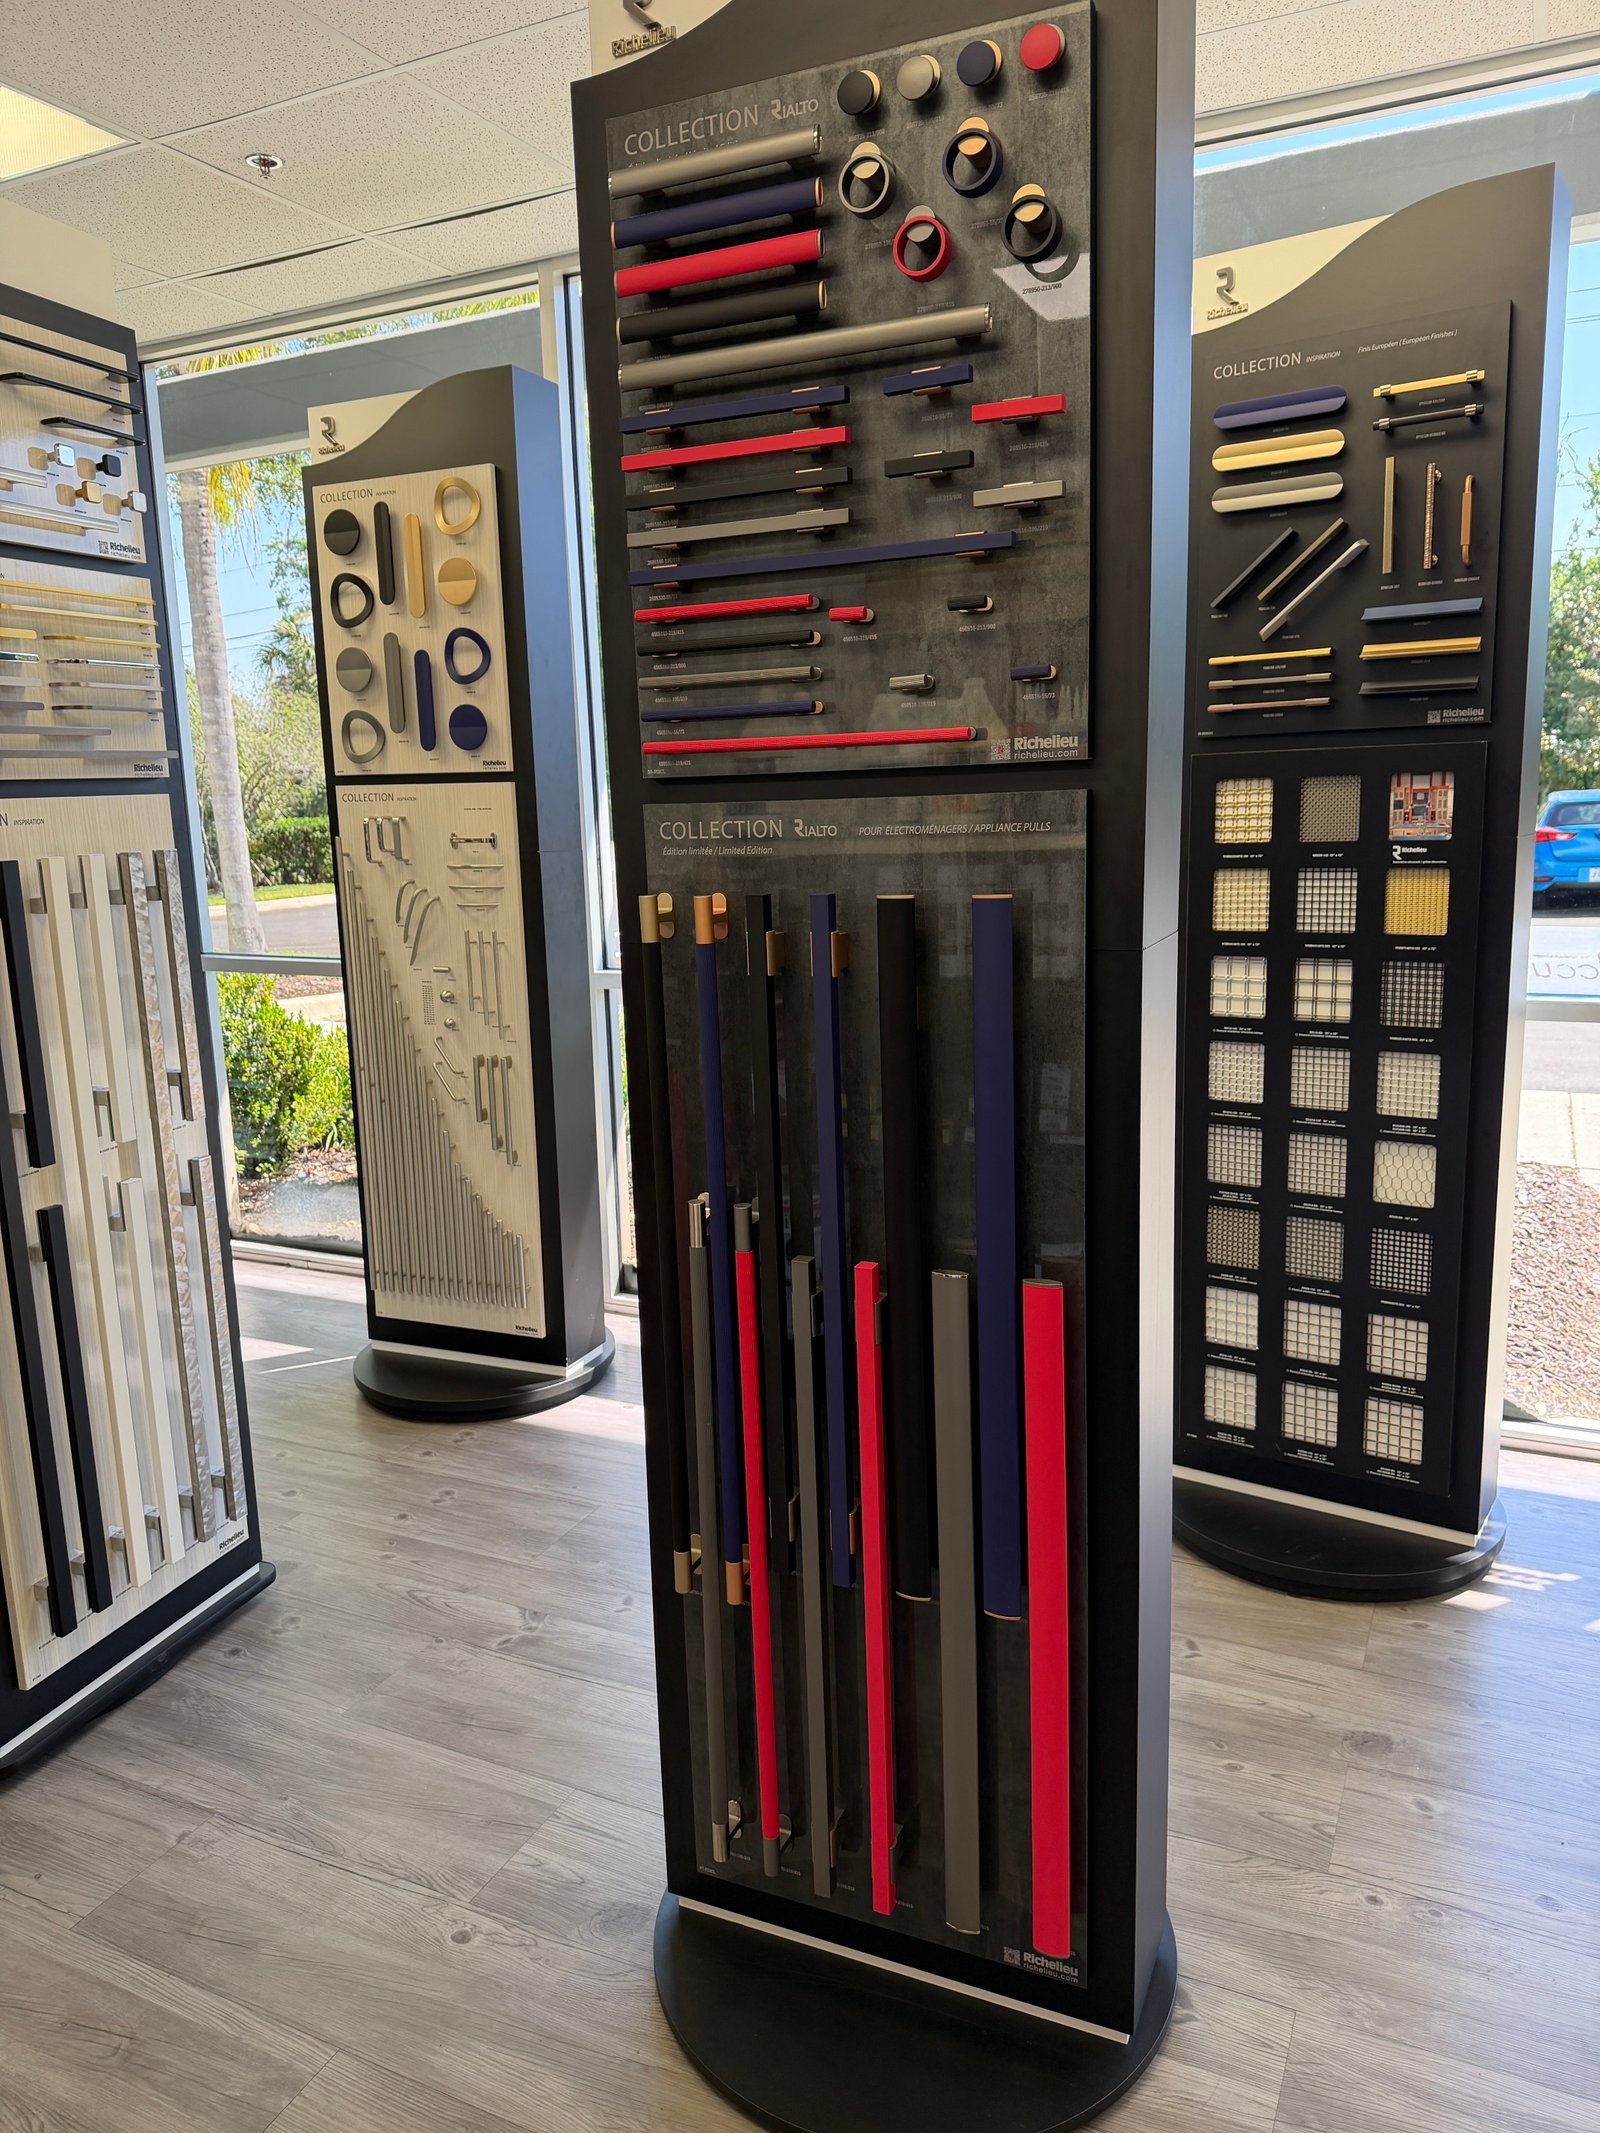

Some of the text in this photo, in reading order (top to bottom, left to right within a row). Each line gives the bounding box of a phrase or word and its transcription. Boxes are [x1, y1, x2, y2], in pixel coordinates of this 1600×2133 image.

[612, 25, 678, 58] Richelieu
[624, 104, 759, 156] COLLECTION
[1372, 340, 1398, 352] Européen
[1402, 334, 1430, 346] European
[1430, 330, 1454, 341] Finishes
[1213, 351, 1341, 380] COLLECTION INSPIRATION
[320, 488, 373, 503] COLLECTION
[110, 541, 141, 554] Richelieu
[1443, 708, 1484, 717] Richelieu
[1014, 734, 1079, 750] Richelieu
[1014, 749, 1078, 760] richelieu.com
[341, 793, 394, 802] COLLECTION
[659, 819, 783, 840] COLLECTION
[859, 826, 882, 836] POUR
[885, 823, 967, 836] ÉLECTROMÉNAGERS
[974, 822, 1022, 834] APPLIANCE
[1023, 821, 1051, 832] PULLS
[662, 846, 687, 856] Édition
[688, 846, 713, 856] limitée
[718, 846, 746, 856] Limited
[746, 845, 773, 855] Edition
[1023, 1951, 1079, 1977] Richelieu
[1023, 1962, 1079, 1984] richelieu.com
